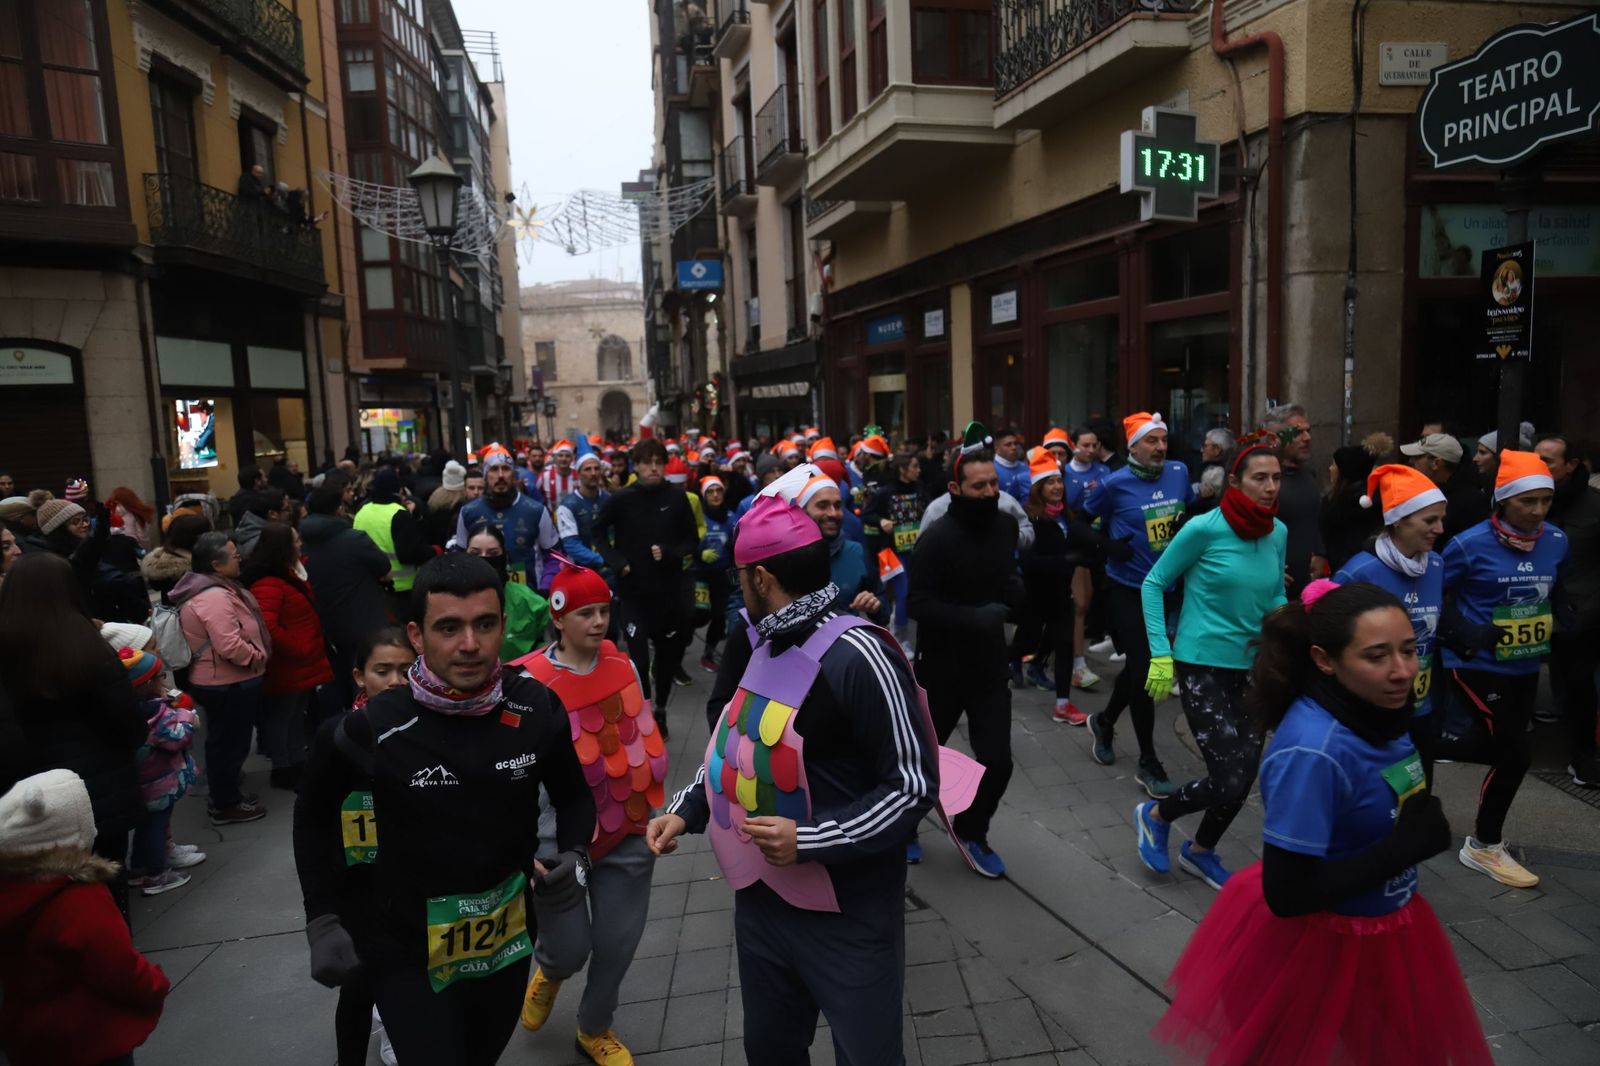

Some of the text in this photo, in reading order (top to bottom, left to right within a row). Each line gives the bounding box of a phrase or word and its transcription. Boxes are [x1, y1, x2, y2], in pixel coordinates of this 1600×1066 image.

[1404, 48, 1432, 58] CALLE
[1409, 60, 1421, 68] DE
[1458, 50, 1562, 105] TEATRO
[1443, 88, 1581, 148] PRINCIPAL
[1140, 148, 1205, 182] 17:31
[1463, 216, 1480, 230] Un
[1538, 214, 1551, 229] la
[1554, 213, 1591, 229] salud
[1152, 490, 1164, 500] 46
[1517, 561, 1534, 572] 46
[1404, 592, 1419, 604] 46
[495, 753, 536, 770] acquire
[441, 907, 509, 956] 1124
[459, 961, 490, 973] CAJA
